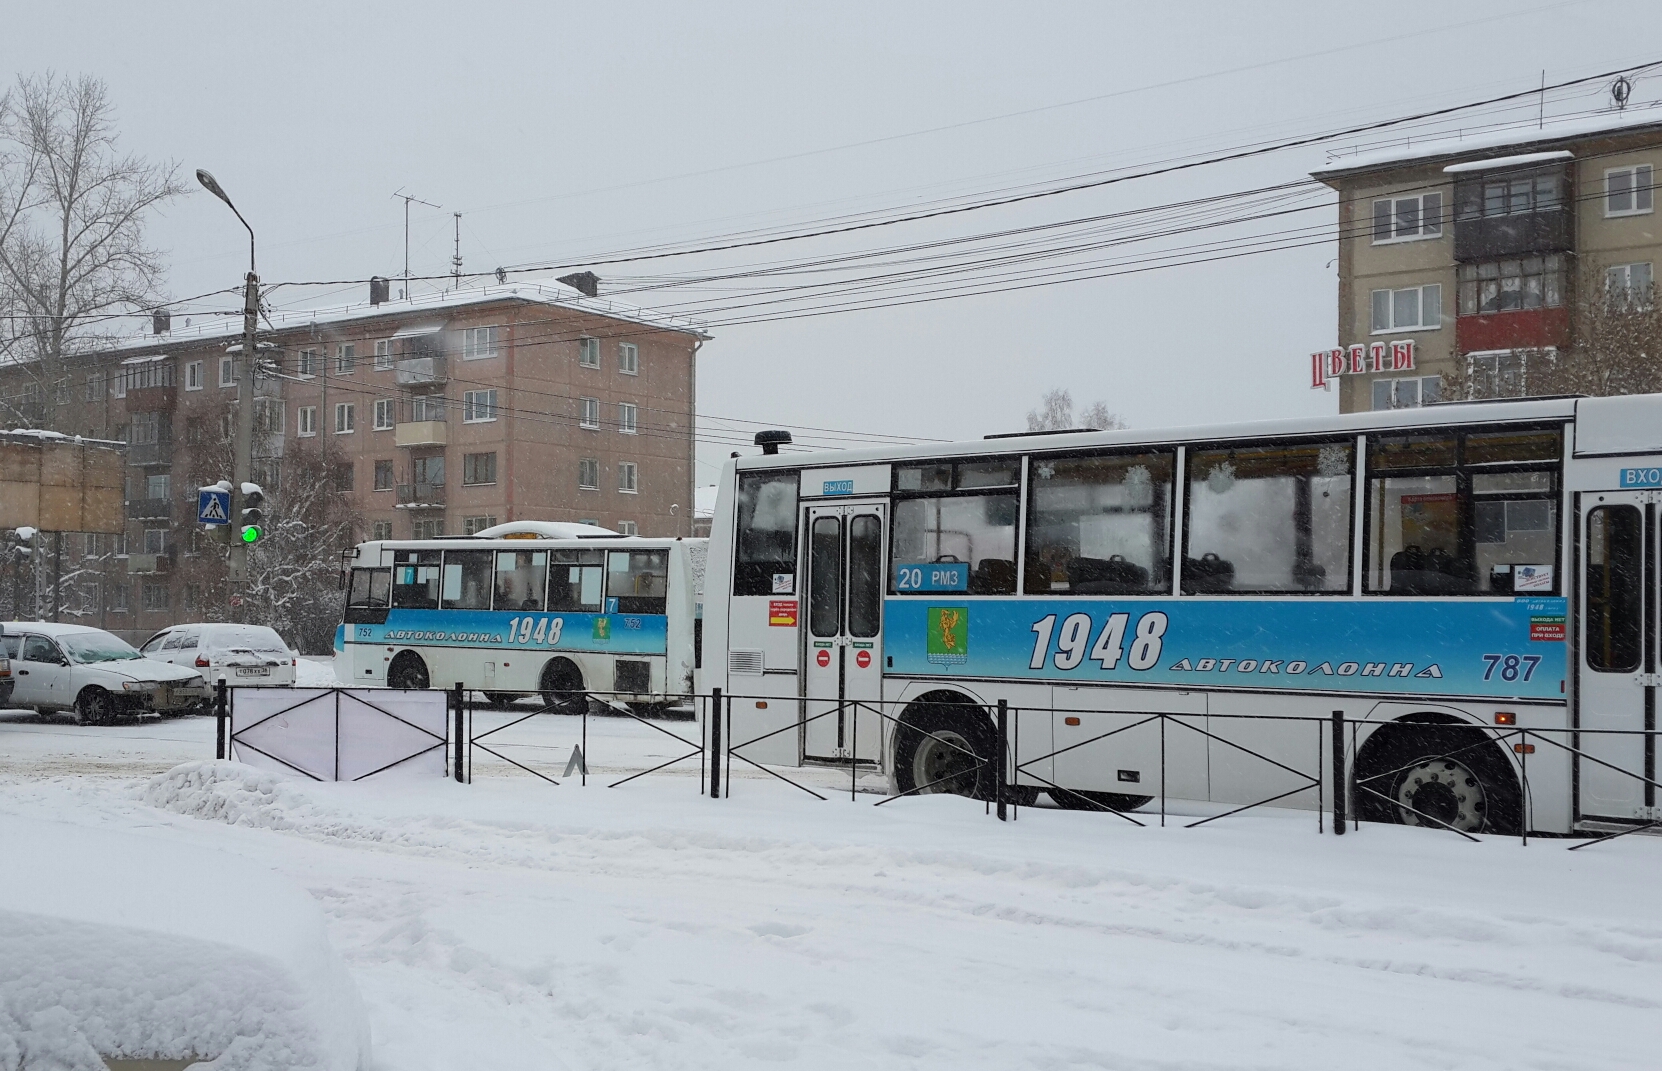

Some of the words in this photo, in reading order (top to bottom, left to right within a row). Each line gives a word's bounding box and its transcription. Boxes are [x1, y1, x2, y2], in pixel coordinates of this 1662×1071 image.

[1311, 341, 1413, 390] ЦВЕТЫ
[1626, 469, 1662, 484] ВХО
[824, 481, 853, 492] ВЫХОД
[406, 569, 412, 582] 7
[898, 568, 922, 588] 20
[931, 571, 958, 585] РМЗ
[608, 598, 616, 611] 7
[507, 617, 564, 644] 1948
[624, 618, 642, 630] 752
[359, 627, 372, 637] 752
[384, 630, 502, 644] АВТОКОЛОННА
[1029, 611, 1168, 671] 1948
[1169, 657, 1443, 678] АВТОКОЛОННА
[1482, 653, 1542, 682] 787
